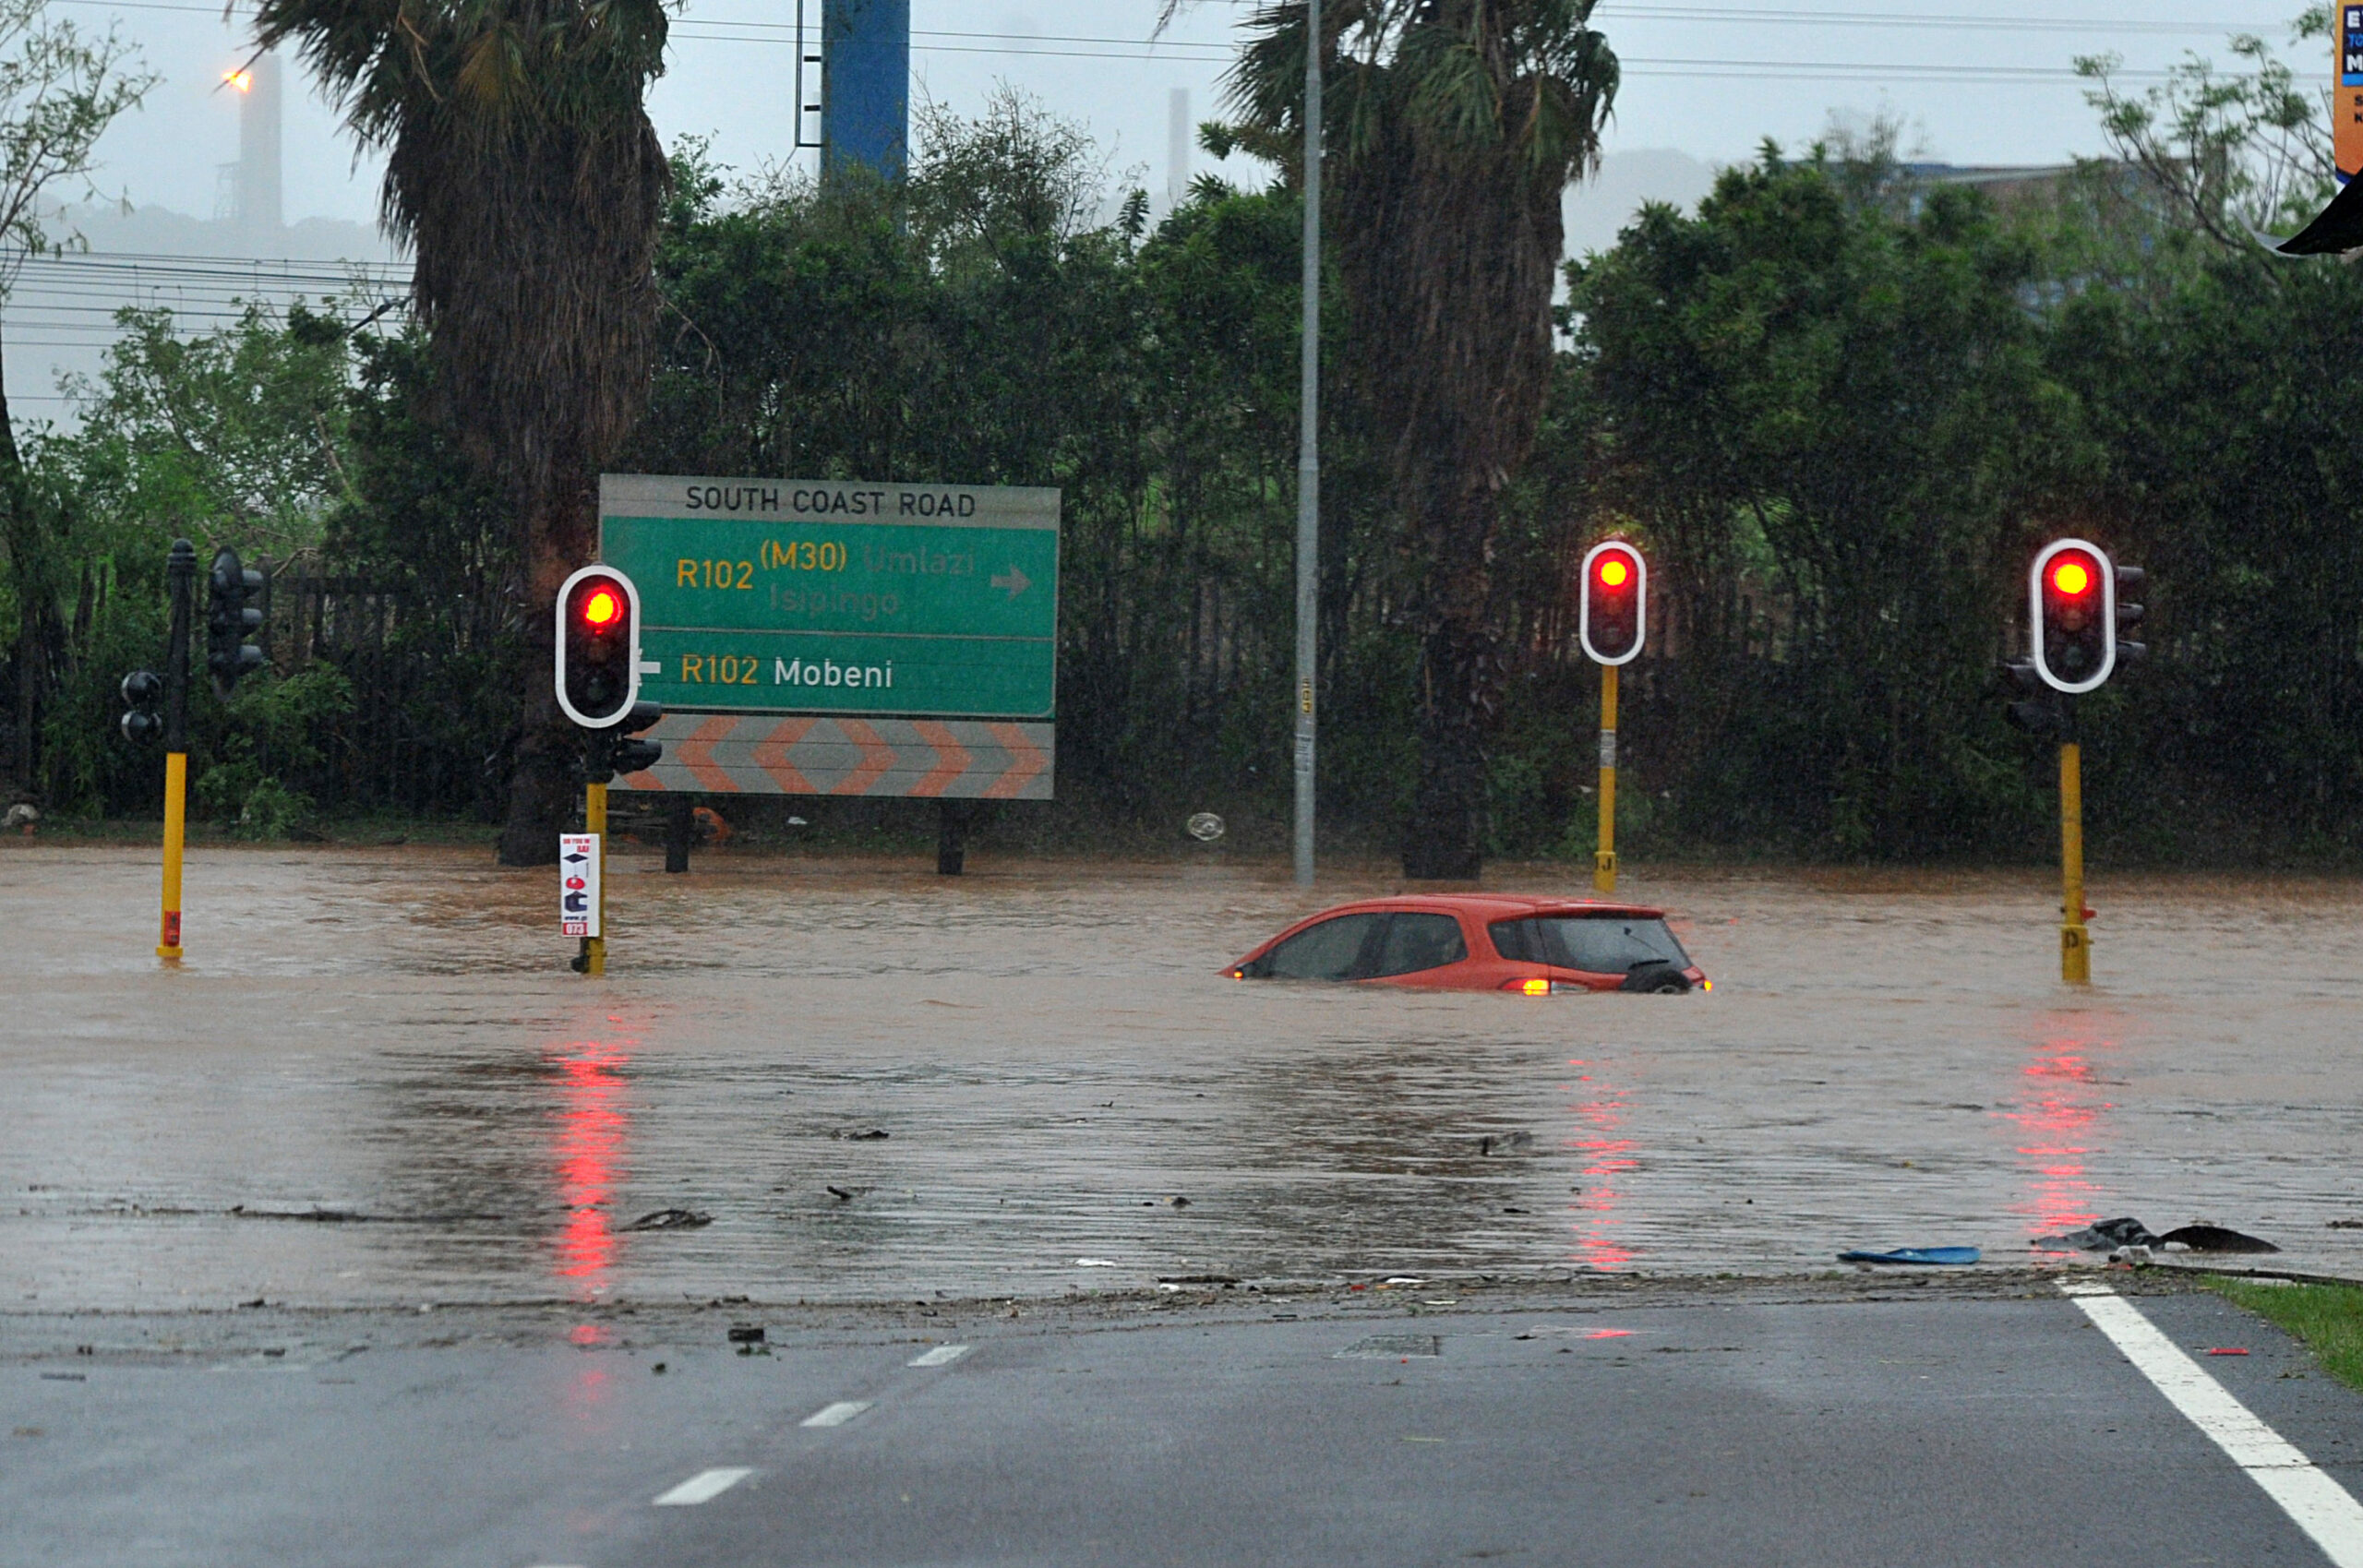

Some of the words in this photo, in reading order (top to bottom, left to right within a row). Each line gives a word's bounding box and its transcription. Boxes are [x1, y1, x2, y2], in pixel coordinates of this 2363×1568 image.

[686, 485, 779, 512] SOUTH
[793, 489, 884, 515] COAST
[898, 492, 977, 518] ROAD
[677, 558, 753, 591] R102
[760, 539, 847, 572] (M30)
[863, 545, 976, 576] Umlazi
[770, 584, 899, 622] Isipingo
[682, 654, 759, 685] R102
[774, 656, 893, 688] Mobeni
[566, 923, 584, 934] 073
